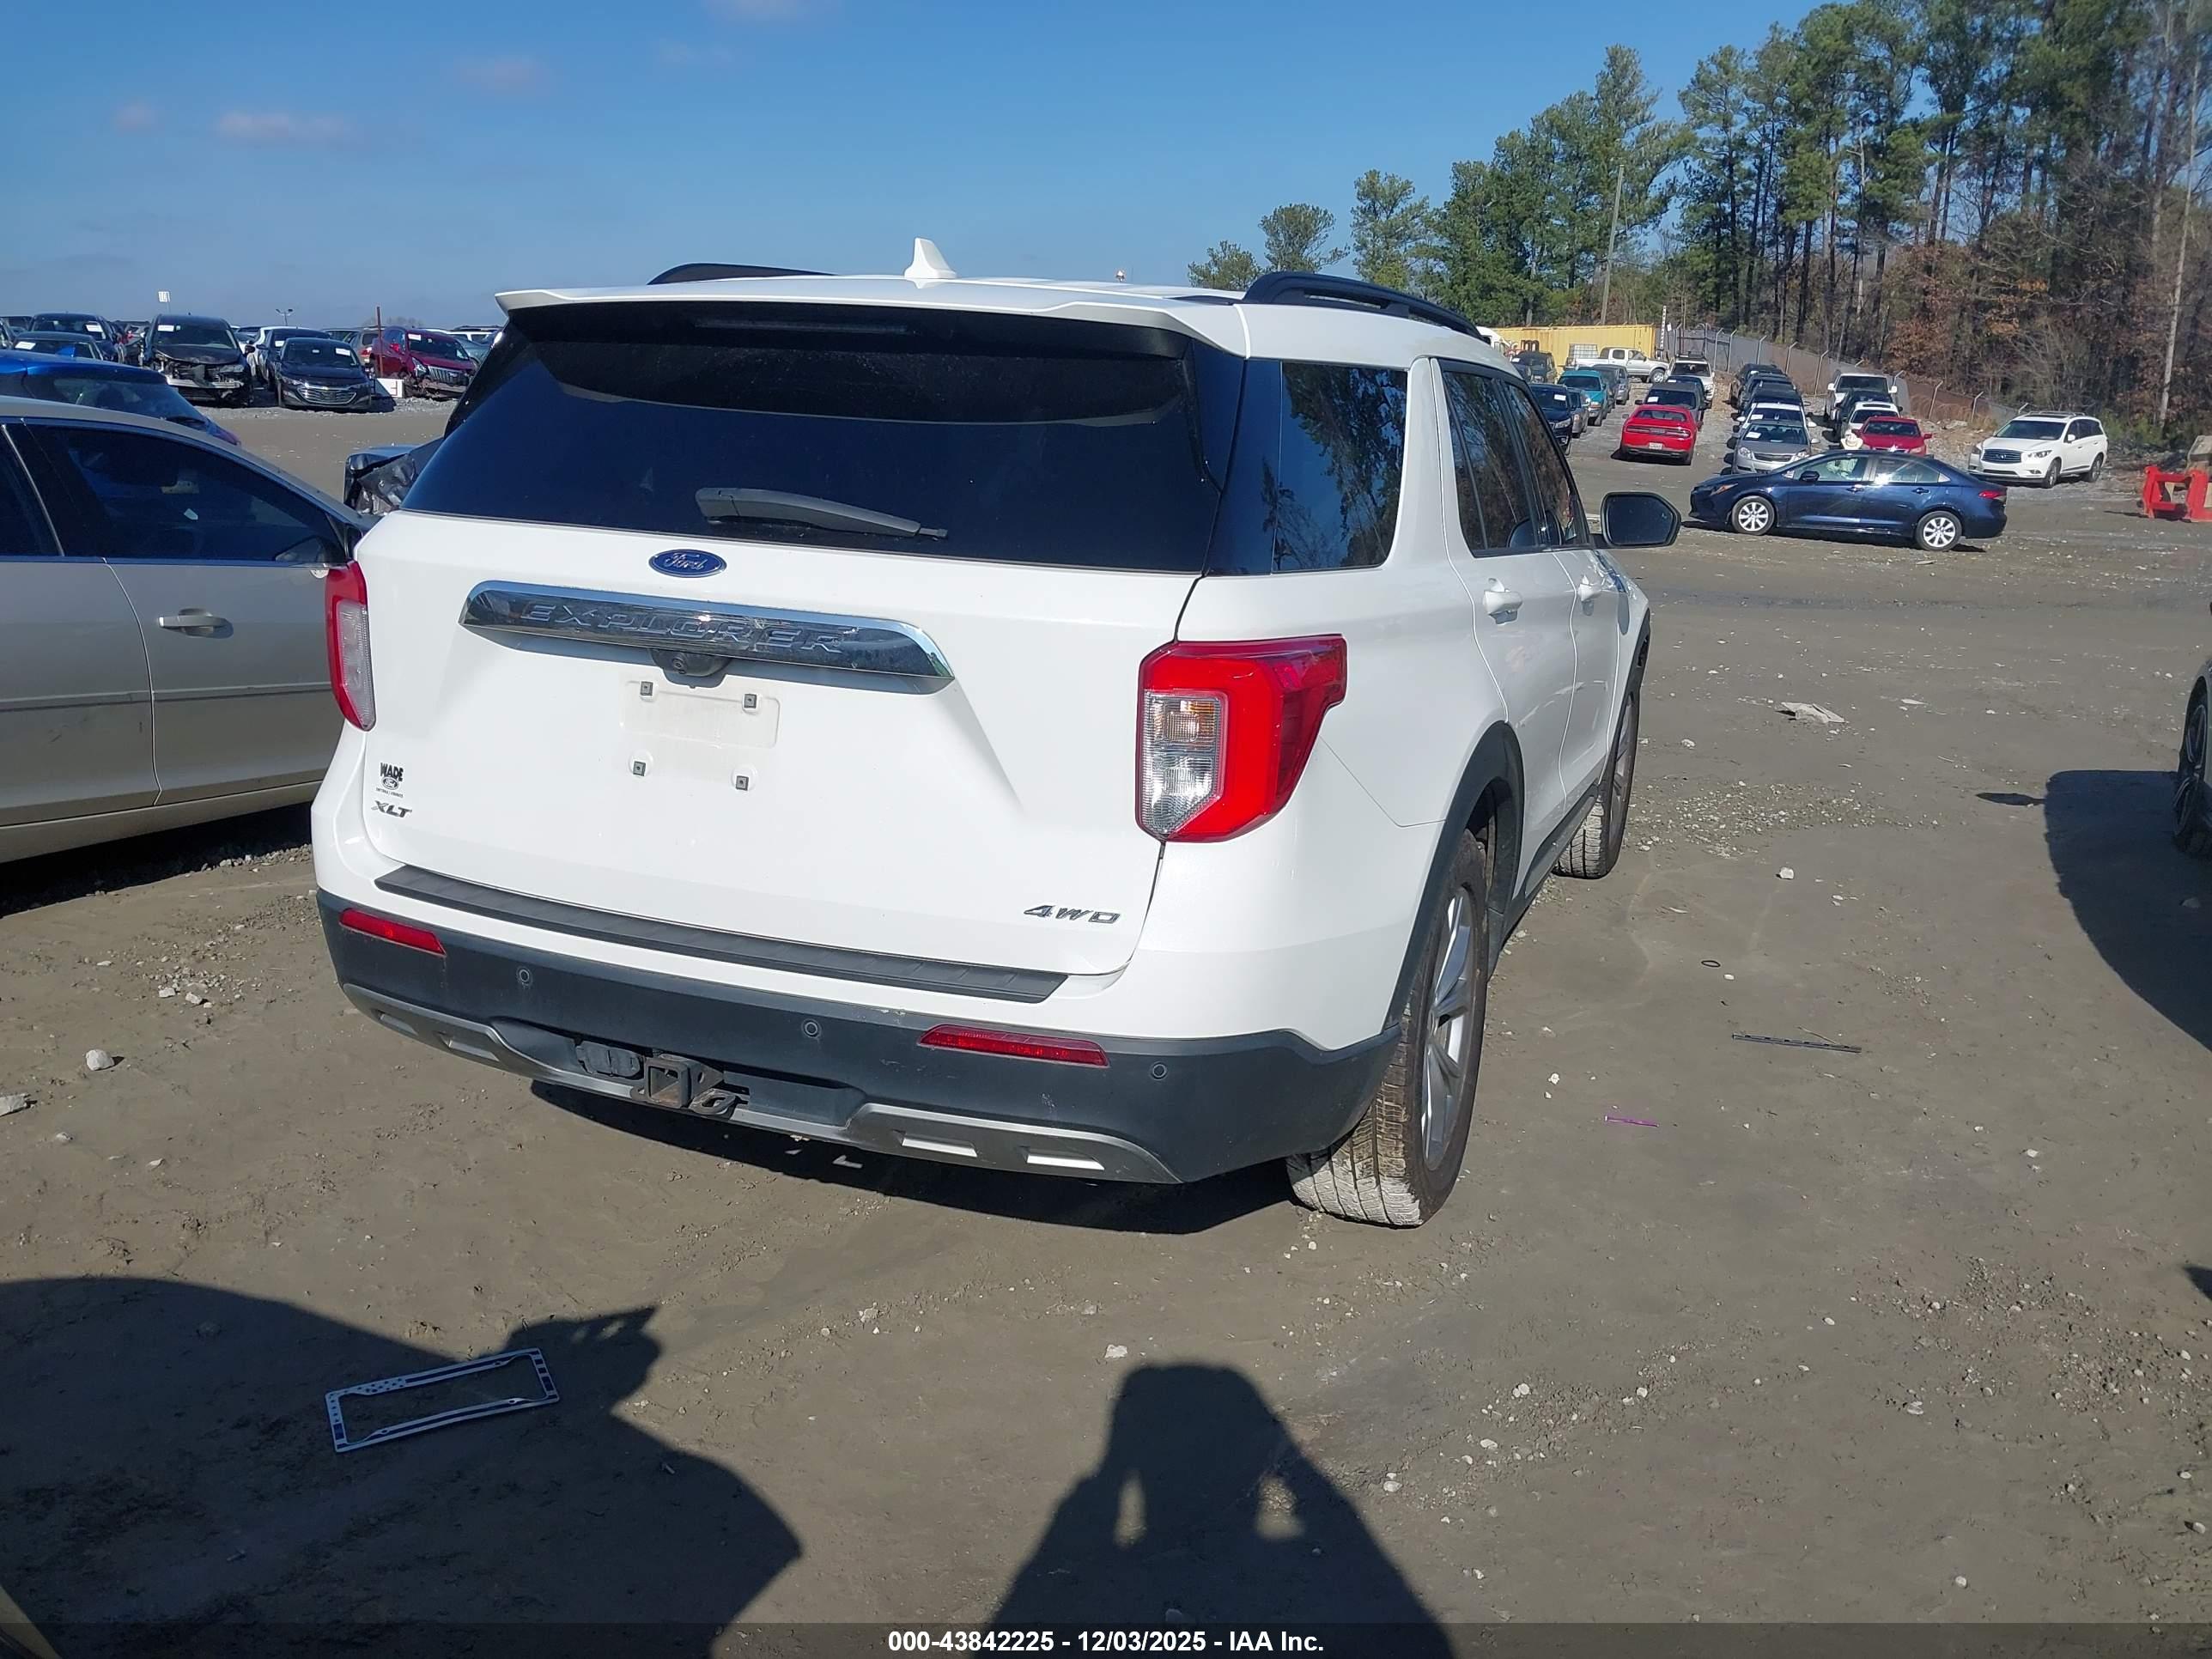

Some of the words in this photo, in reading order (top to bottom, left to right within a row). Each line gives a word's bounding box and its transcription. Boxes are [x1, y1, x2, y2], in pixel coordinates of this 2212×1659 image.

[664, 551, 708, 570] Ford
[520, 604, 846, 654] EXPLORER
[380, 762, 404, 782] WADE
[371, 800, 412, 817] XLT
[1023, 904, 1121, 925] 4WD
